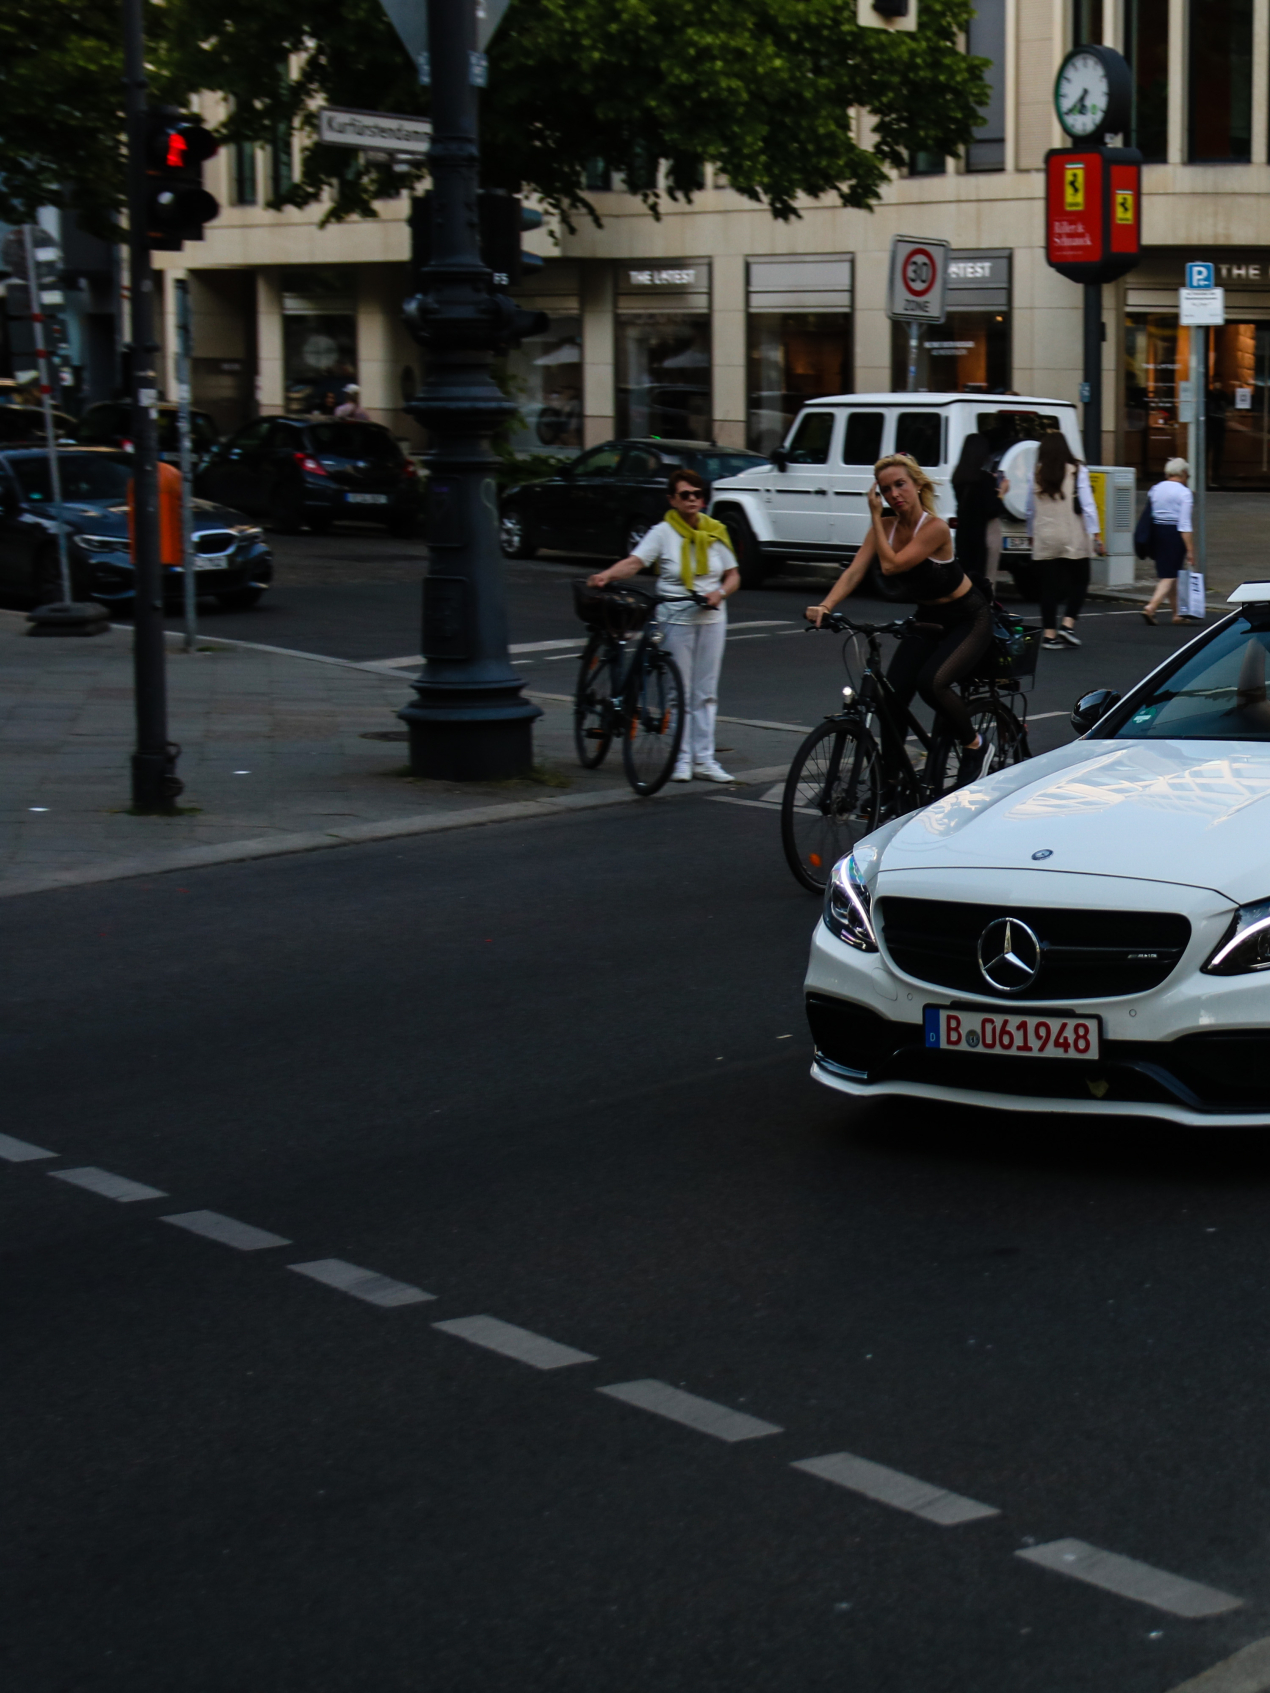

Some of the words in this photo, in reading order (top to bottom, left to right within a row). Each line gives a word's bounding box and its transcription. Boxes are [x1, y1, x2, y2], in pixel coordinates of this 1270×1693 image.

[629, 270, 652, 285] THE
[653, 269, 697, 284] LATEST
[908, 261, 931, 284] 30
[1219, 264, 1261, 280] THE
[903, 299, 930, 313] ZONE
[930, 1032, 936, 1042] D
[946, 1014, 962, 1046] B
[981, 1017, 1090, 1053] 061948
